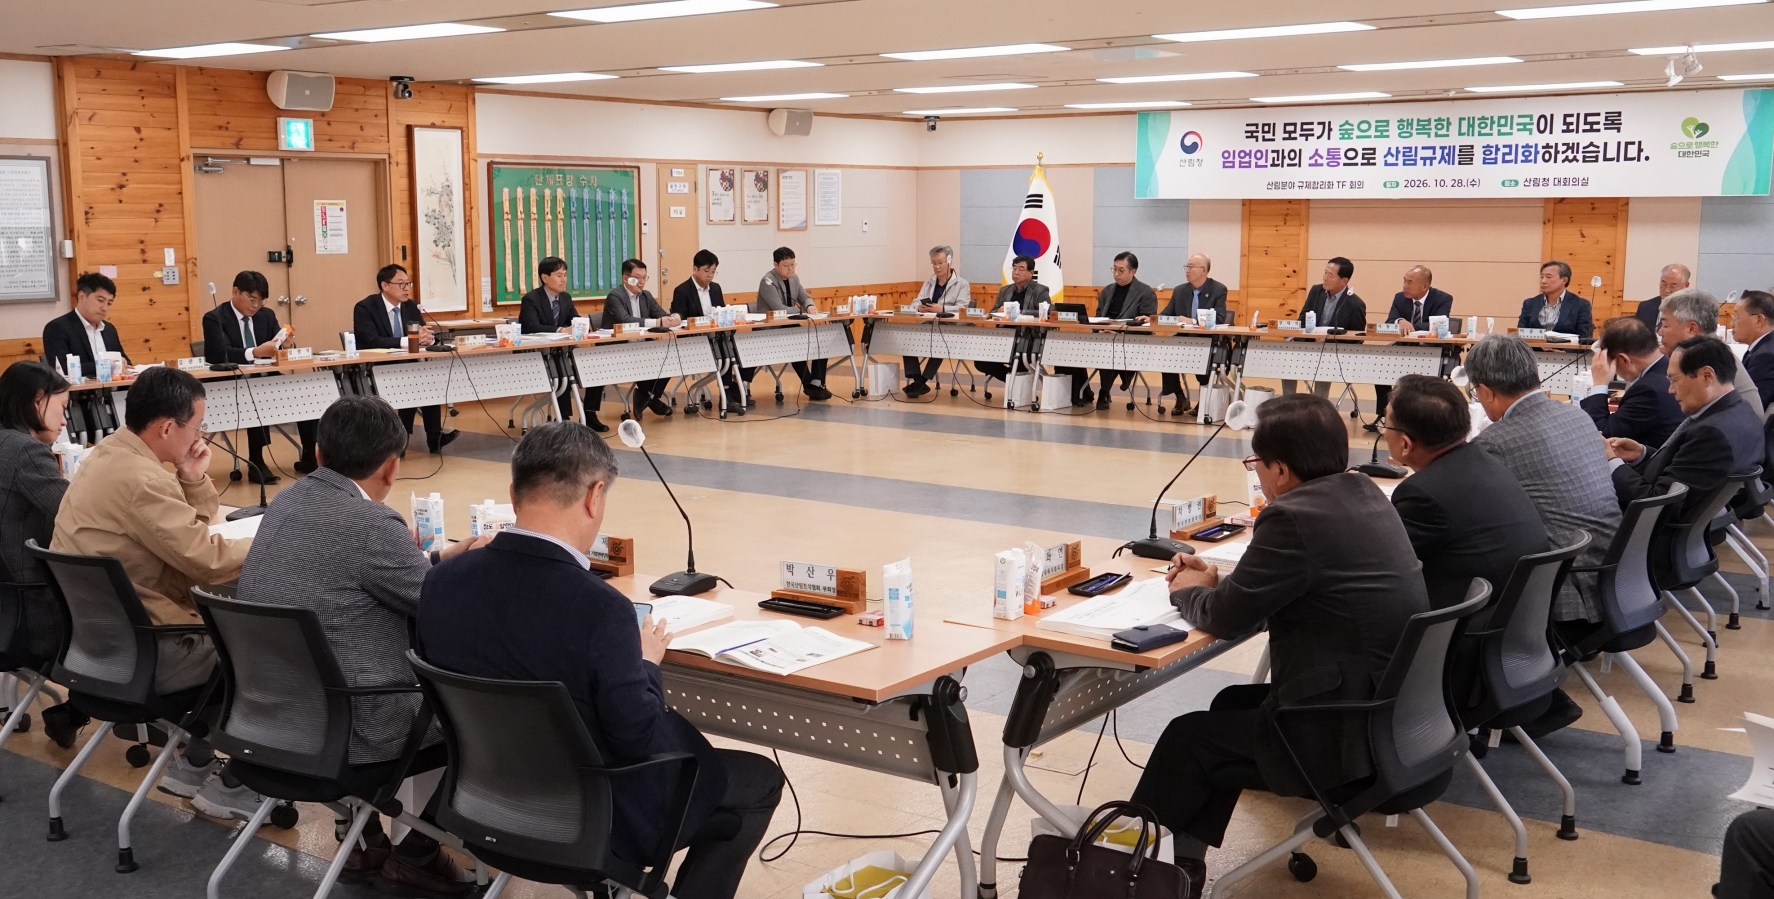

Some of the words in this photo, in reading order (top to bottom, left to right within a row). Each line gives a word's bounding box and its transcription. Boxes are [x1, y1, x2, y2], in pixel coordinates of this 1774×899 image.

[1244, 122, 1276, 142] 국민
[1281, 121, 1333, 141] 모두가
[1338, 119, 1391, 140] 숲으로
[1396, 117, 1452, 139] 행복한
[1457, 114, 1555, 137] 대한민국이
[1561, 111, 1623, 134] 되도록
[1221, 149, 1303, 169] 임업인과의
[1308, 147, 1377, 168] 소통으로
[1383, 145, 1476, 167] 산림규제를
[1481, 140, 1651, 165] 합리화하겠습니다.
[1677, 149, 1710, 158] 대한민국
[1179, 158, 1204, 167] 산림청
[1266, 181, 1296, 190] 산림분야
[1297, 181, 1335, 190] 규제합리화
[1336, 180, 1347, 189] TF
[1349, 180, 1365, 189] 회의
[1403, 179, 1431, 188] 2026.
[1434, 179, 1449, 188] 10.
[1450, 178, 1481, 188] 28.(수)
[1523, 177, 1550, 187] 산림청
[1553, 176, 1590, 187] 대회의실
